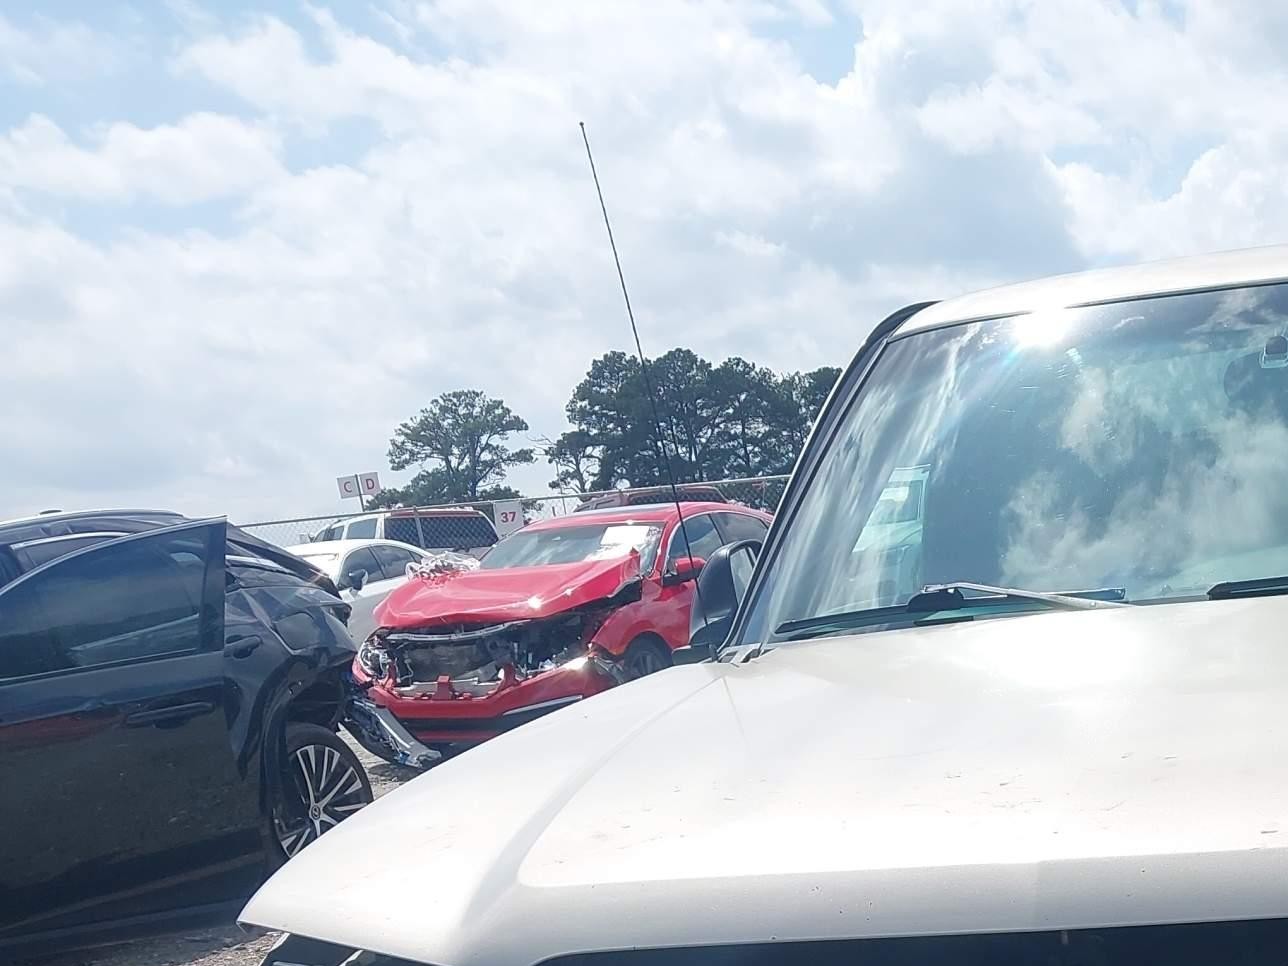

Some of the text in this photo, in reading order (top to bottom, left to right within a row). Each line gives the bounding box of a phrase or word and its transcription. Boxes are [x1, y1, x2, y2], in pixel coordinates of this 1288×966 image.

[343, 481, 353, 493] C
[365, 478, 375, 490] D
[501, 511, 517, 523] 37
